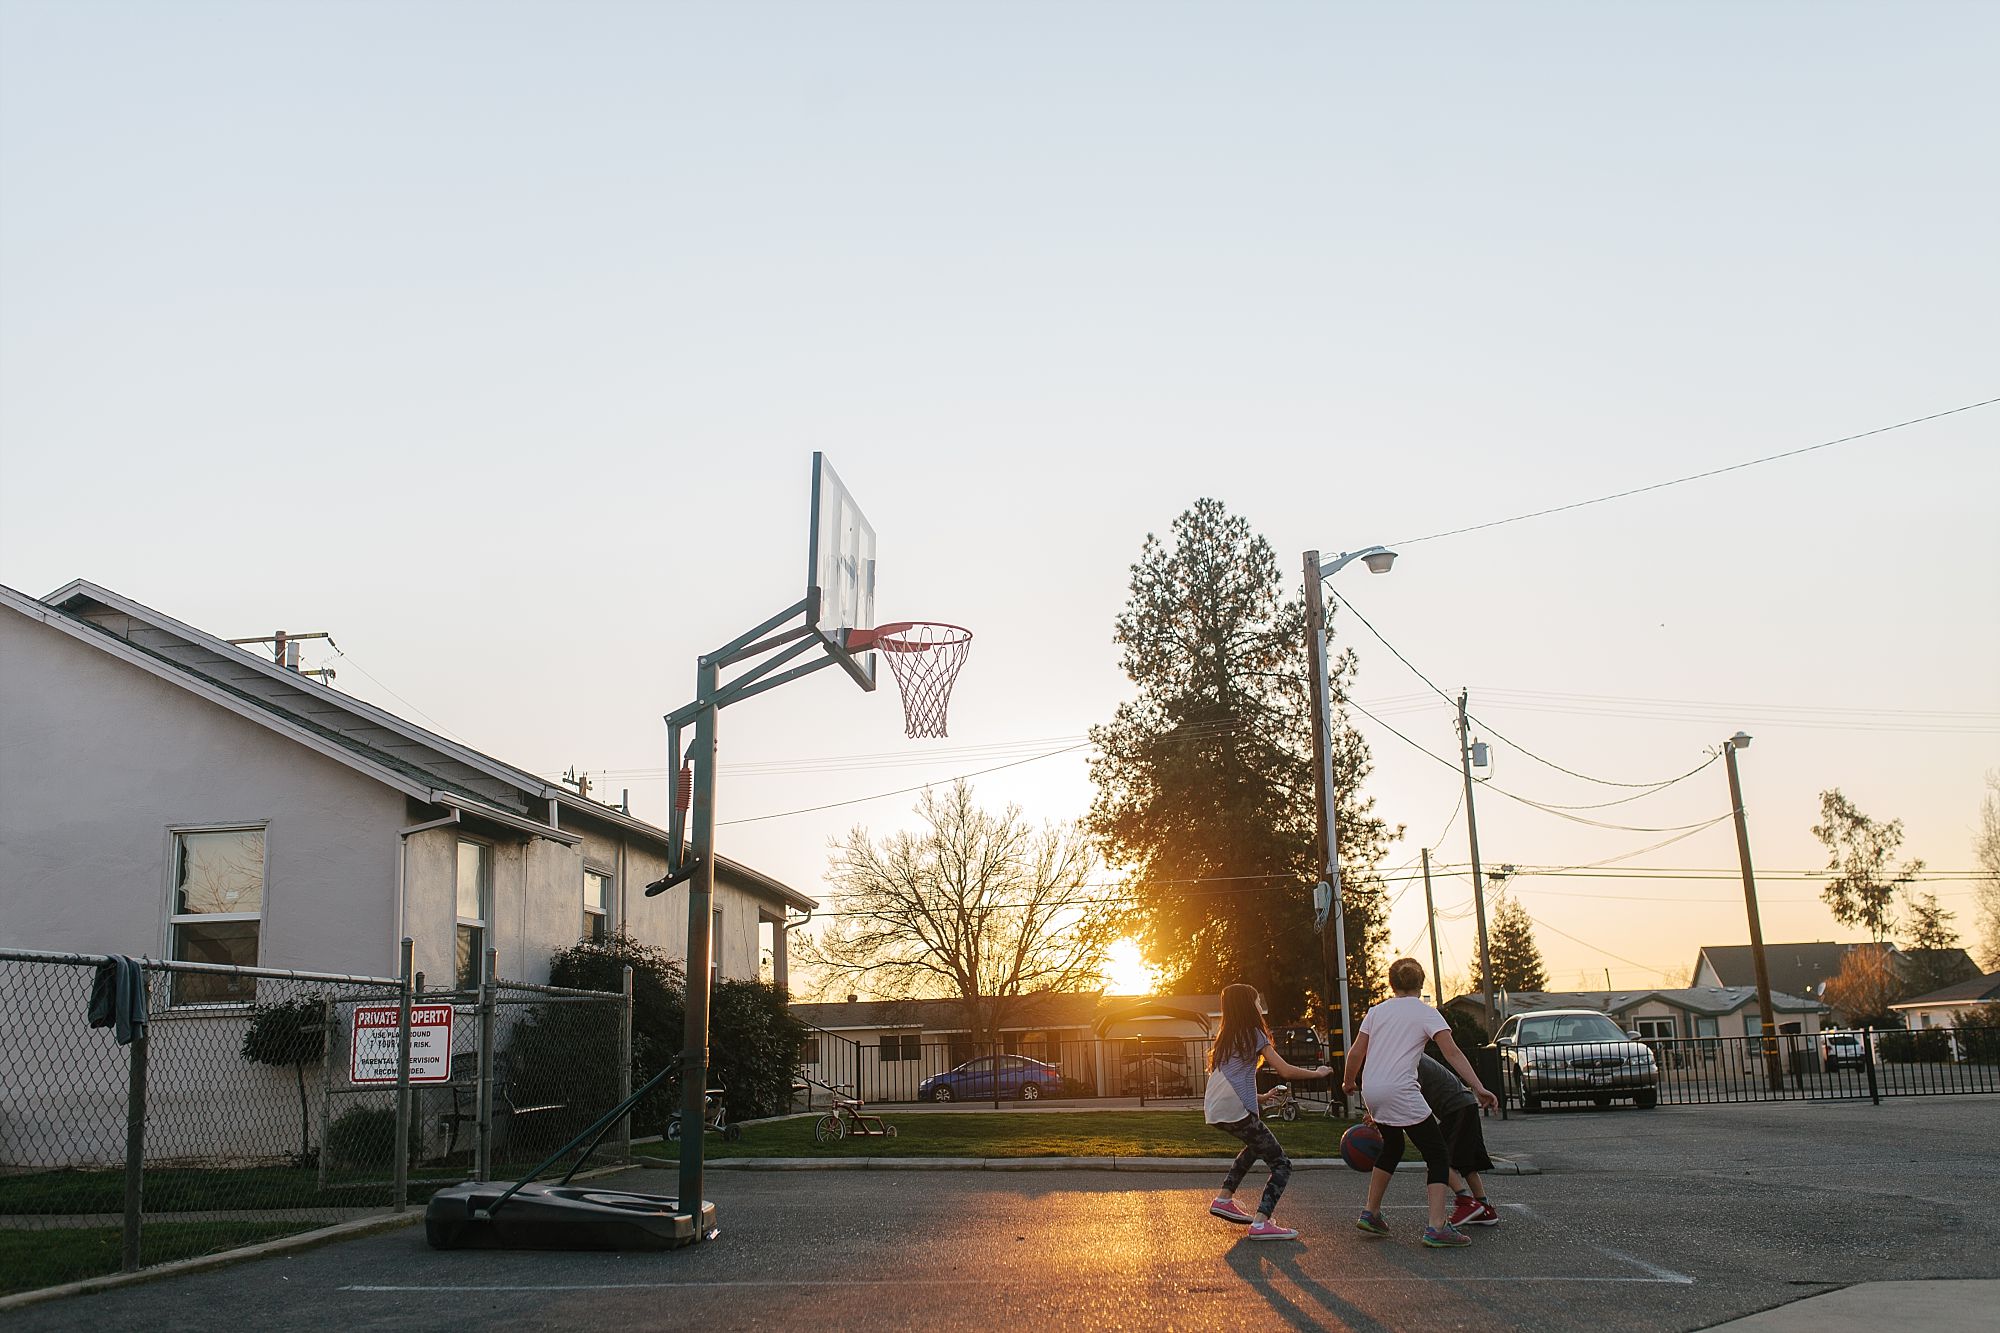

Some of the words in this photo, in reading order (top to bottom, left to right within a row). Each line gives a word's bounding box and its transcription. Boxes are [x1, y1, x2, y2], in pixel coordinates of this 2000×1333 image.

[358, 1011, 397, 1025] PRIVATE
[403, 1010, 449, 1024] OPERTY
[388, 1031, 431, 1039] PLAOUND
[396, 1056, 440, 1064] SERVISION
